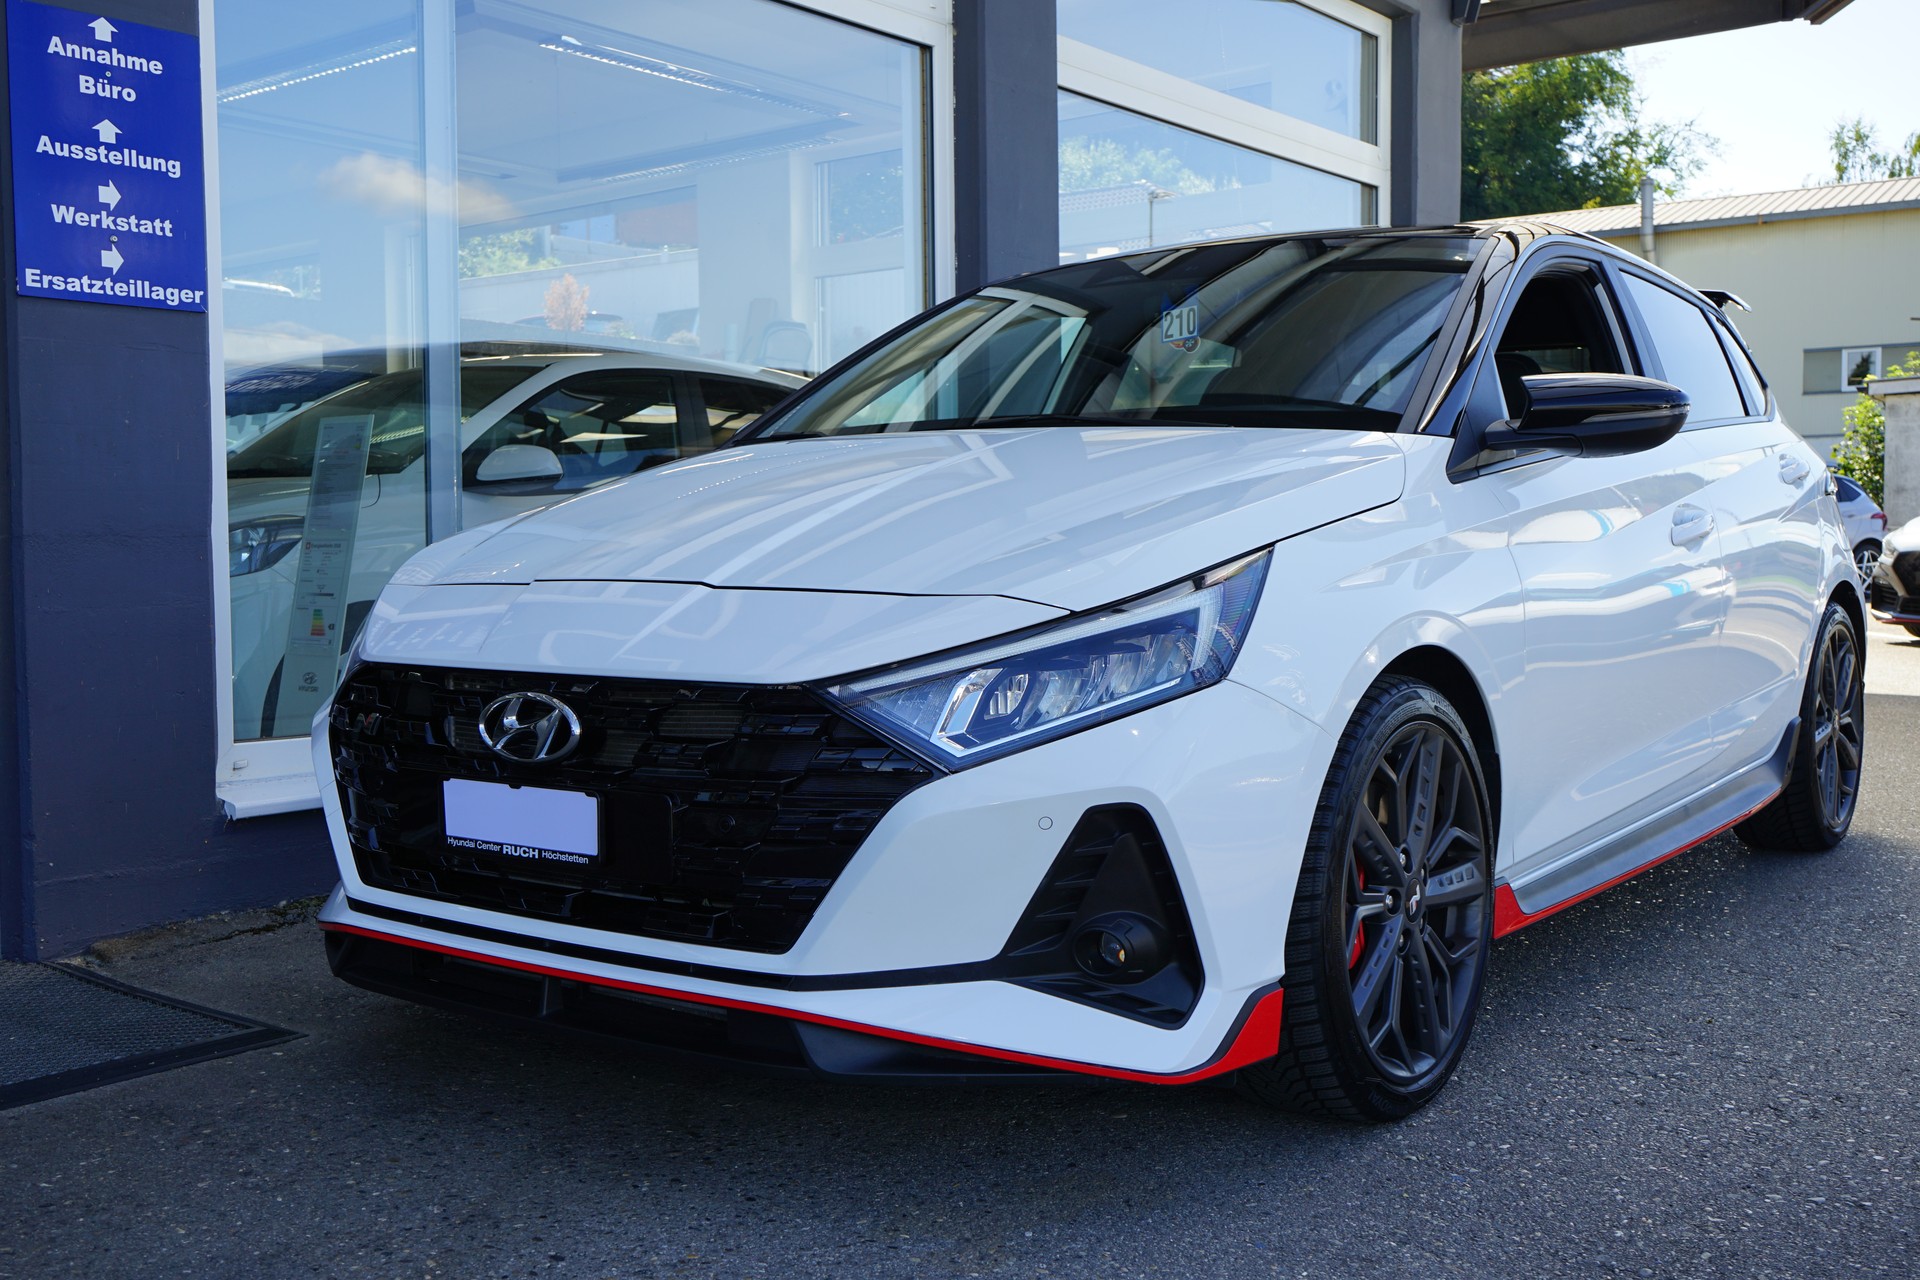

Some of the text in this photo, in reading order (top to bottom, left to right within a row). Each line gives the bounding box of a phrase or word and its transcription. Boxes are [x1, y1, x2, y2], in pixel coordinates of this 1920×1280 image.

[47, 35, 163, 75] Annahme
[79, 74, 137, 102] Büro
[36, 135, 181, 178] Ausstellung
[51, 203, 173, 237] Werkstatt
[25, 268, 204, 306] Ersatzteillager
[1163, 307, 1197, 340] 210
[447, 836, 589, 864] Hyundai Center RUCH Höchstetten
